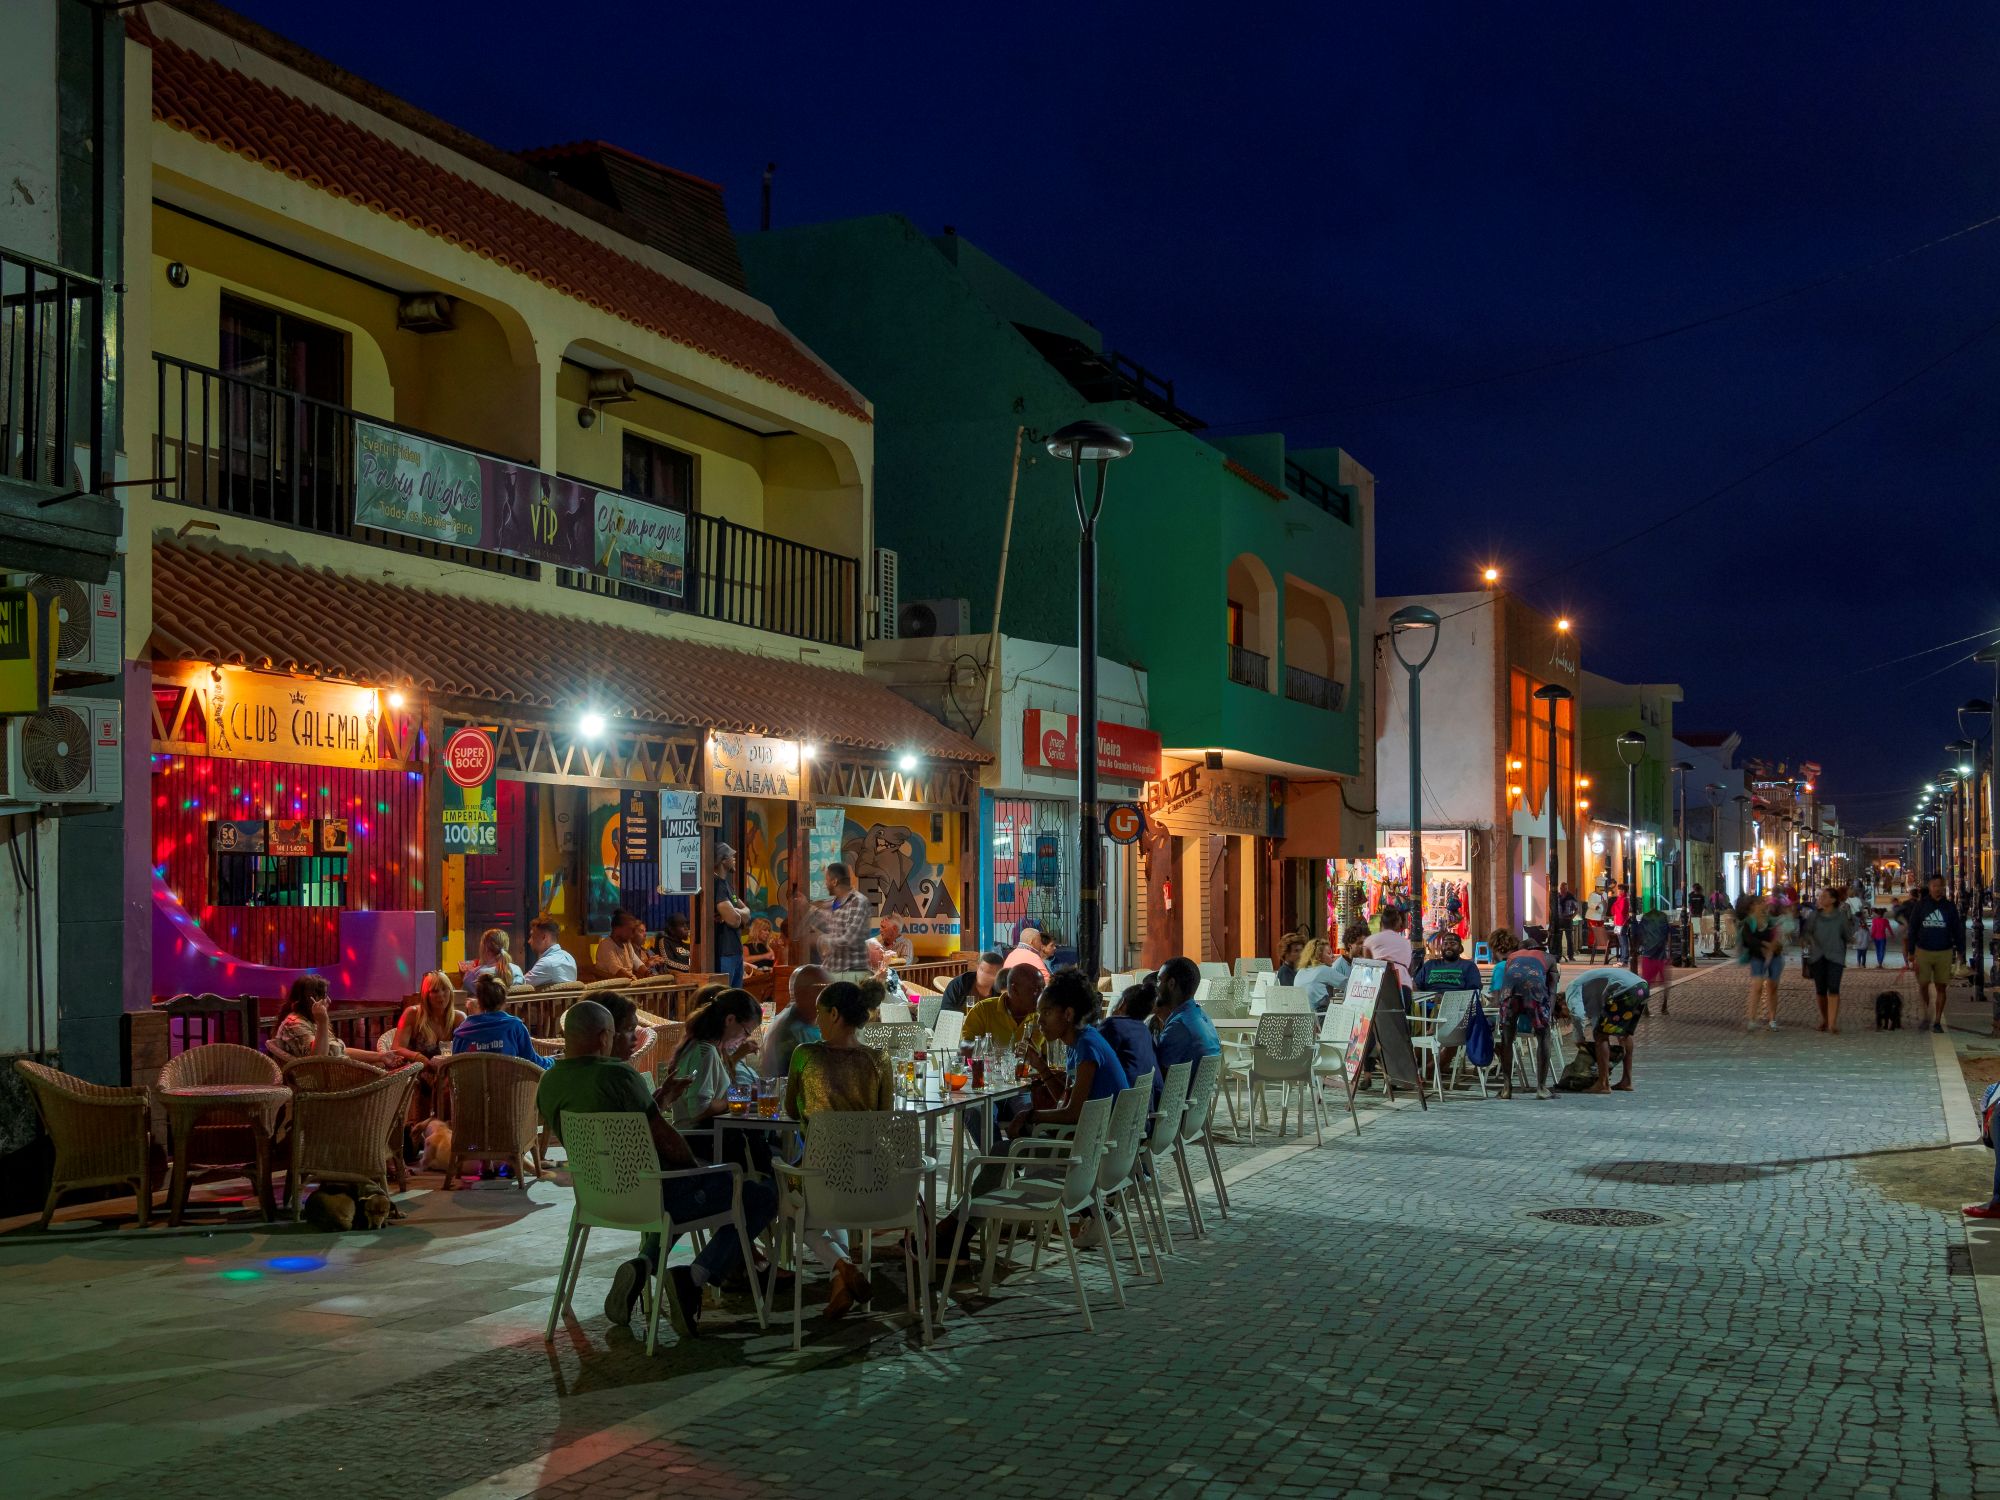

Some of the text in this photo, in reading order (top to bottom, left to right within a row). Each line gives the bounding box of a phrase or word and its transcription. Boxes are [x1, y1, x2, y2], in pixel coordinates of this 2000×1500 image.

[362, 435, 421, 467] Every Friday
[362, 452, 480, 514] Party Nights
[380, 500, 405, 520] Todas
[530, 503, 559, 545] VIP
[230, 701, 360, 751] CLUB CALEMA
[454, 747, 485, 759] SUPER
[1049, 735, 1065, 752] Image
[1097, 736, 1122, 757] Vieira
[455, 757, 483, 769] BOCK
[1048, 746, 1066, 761] Service
[1107, 758, 1114, 768] As
[1114, 759, 1132, 771] Grandes
[724, 768, 789, 796] CALEMA
[444, 811, 488, 821] IMPERIAL
[704, 811, 720, 823] WIFI
[800, 816, 815, 827] WIFI
[444, 824, 496, 846] 100$ 1€
[669, 819, 699, 837] MUSIC
[676, 839, 699, 859] Tonight
[859, 876, 961, 918] EMA
[900, 923, 929, 935] ABO
